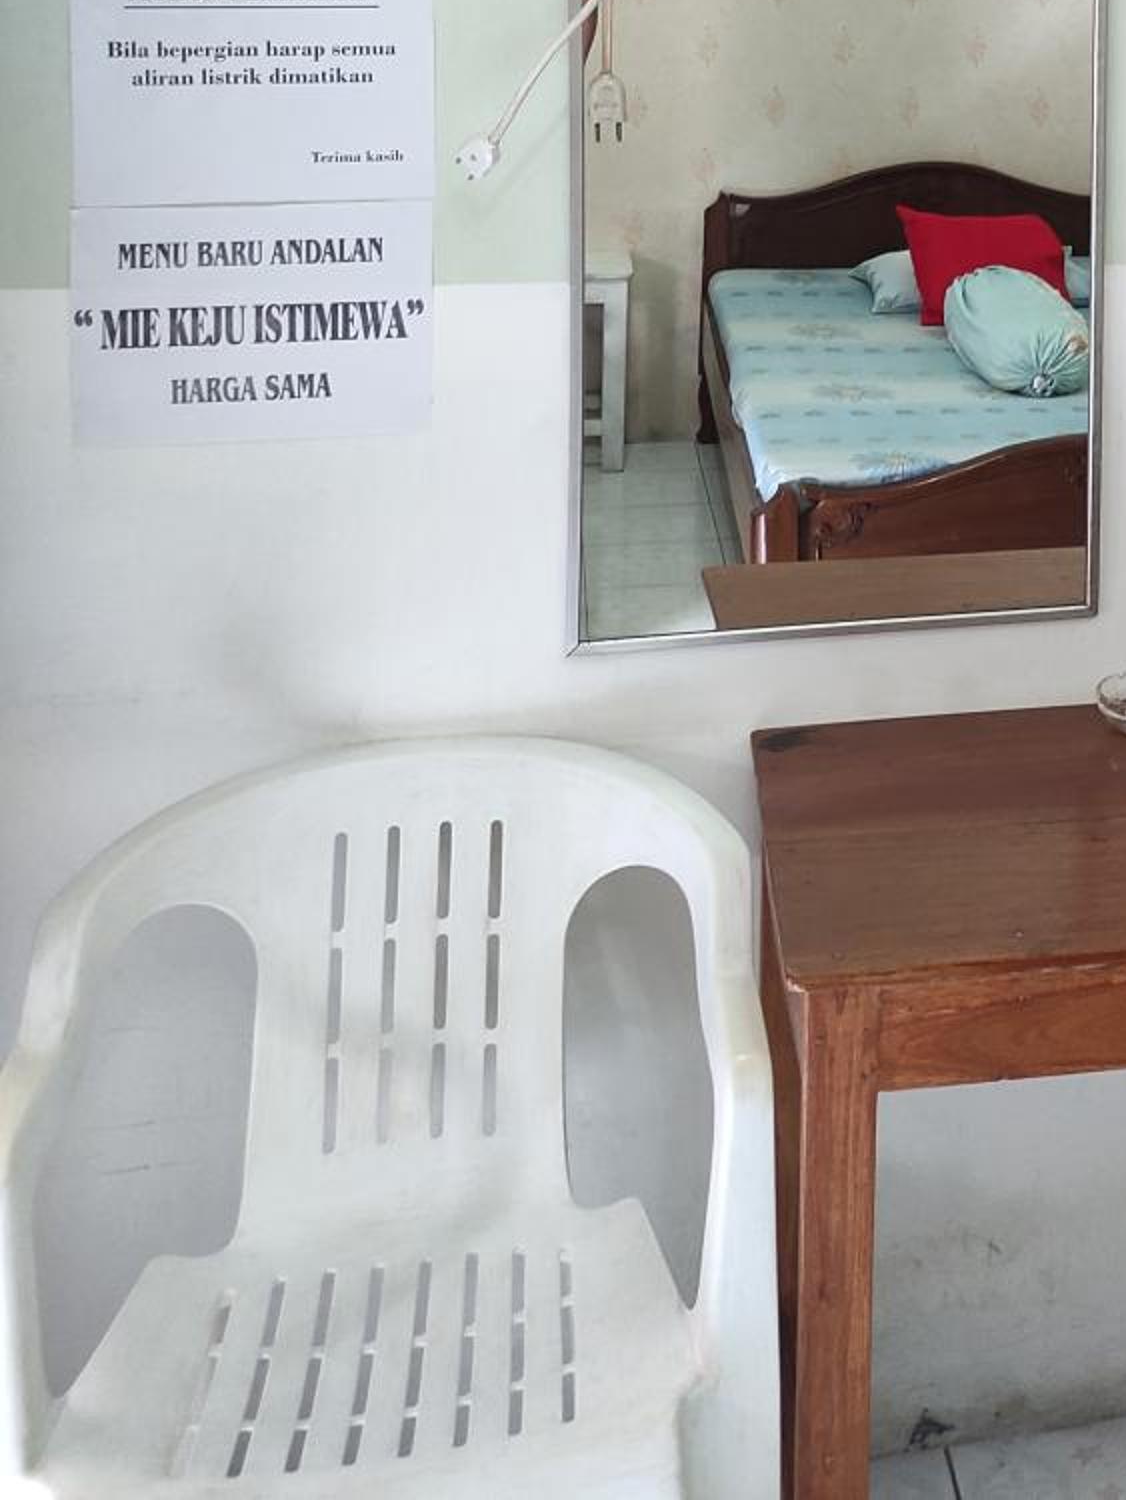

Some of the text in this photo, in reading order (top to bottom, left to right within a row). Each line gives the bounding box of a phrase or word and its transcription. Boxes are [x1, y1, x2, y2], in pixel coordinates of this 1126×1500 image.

[107, 39, 396, 64] Bila bepergian harap semua
[131, 67, 375, 87] aliran listrik dimatikan
[311, 149, 404, 164] Terima kasih
[117, 236, 384, 271] MENU BARU ANDALAN
[167, 305, 247, 348] KEJU
[170, 372, 333, 405] HARGA SAMA
